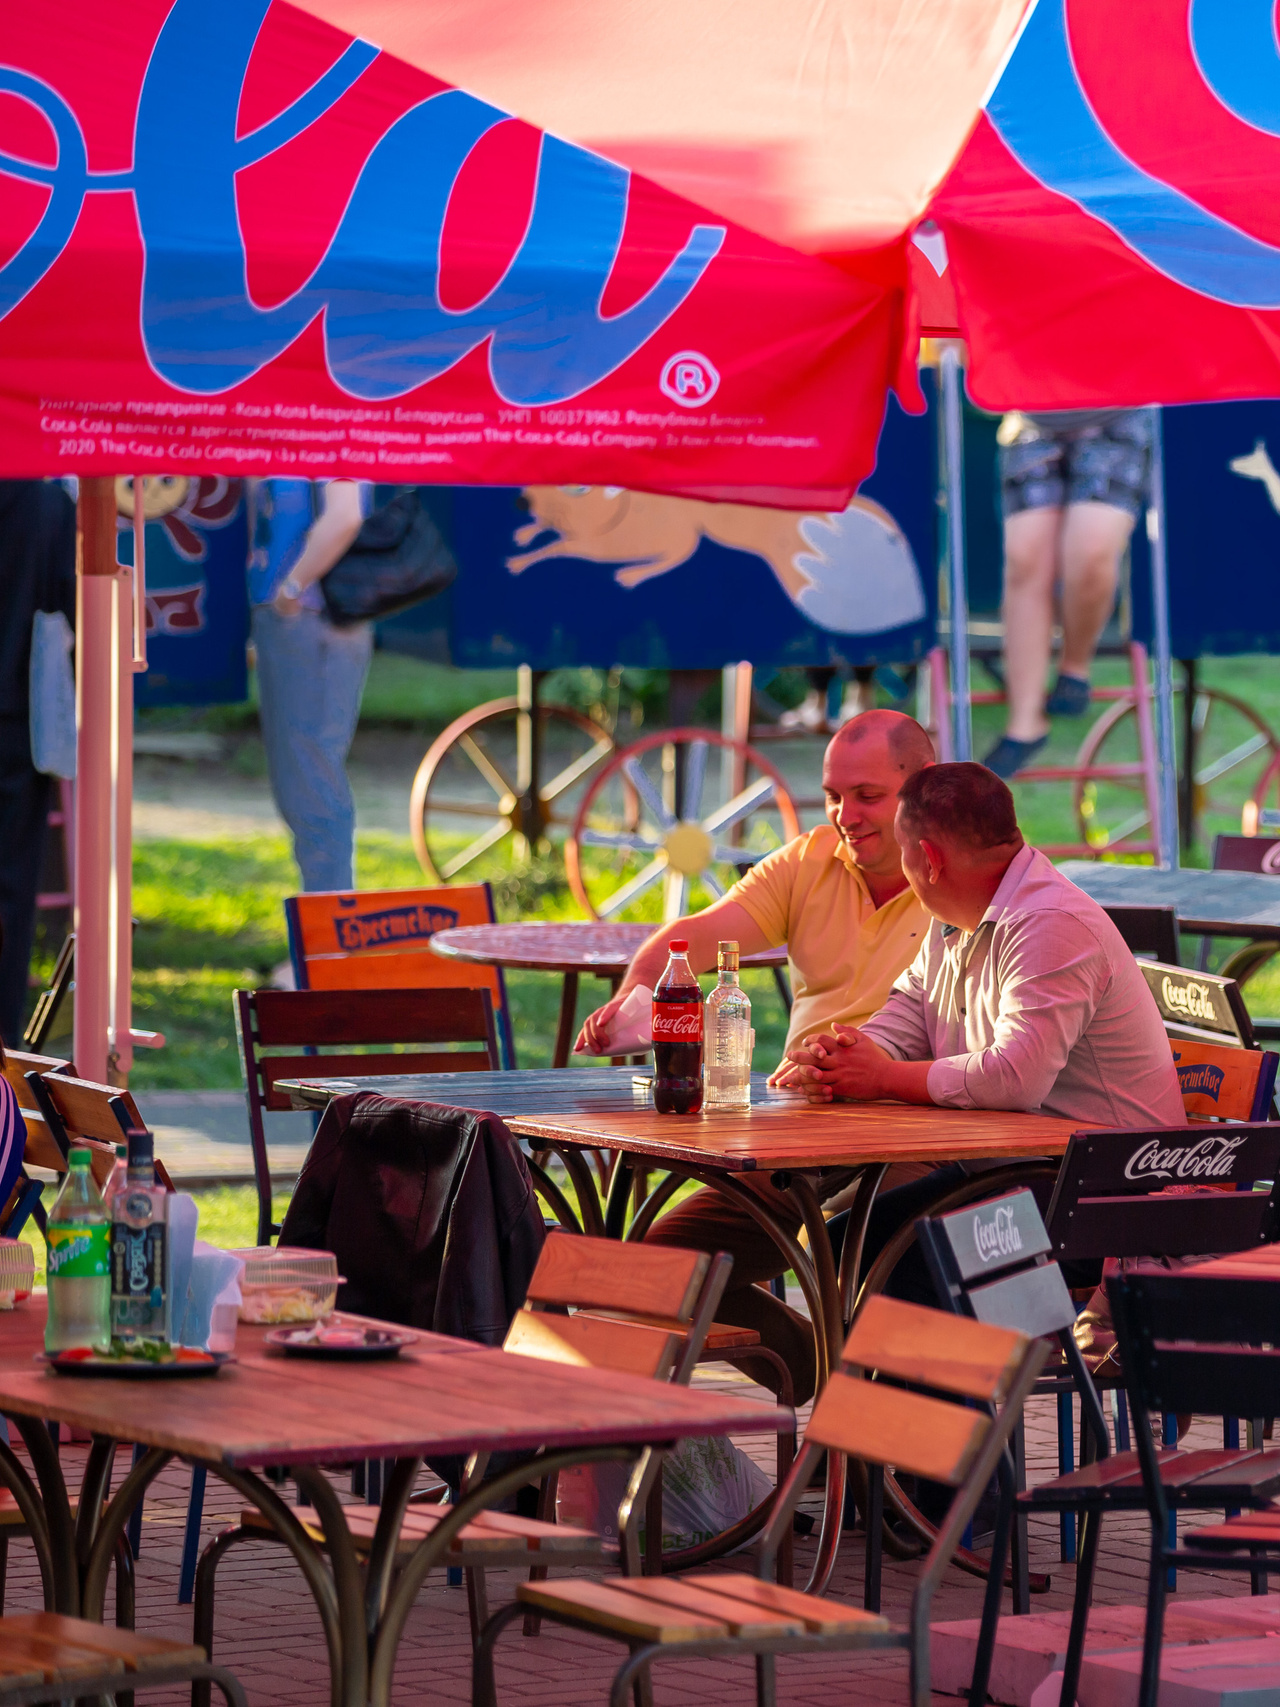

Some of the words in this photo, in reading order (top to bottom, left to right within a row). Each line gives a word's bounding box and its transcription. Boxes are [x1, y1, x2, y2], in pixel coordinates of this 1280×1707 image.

[1161, 975, 1217, 1021] Coca-Cola
[653, 1013, 701, 1034] Coca-Cola
[1124, 1136, 1249, 1180] Coca-Cola
[48, 1235, 91, 1273] Sprite
[972, 1204, 1023, 1262] Coca-Cola
